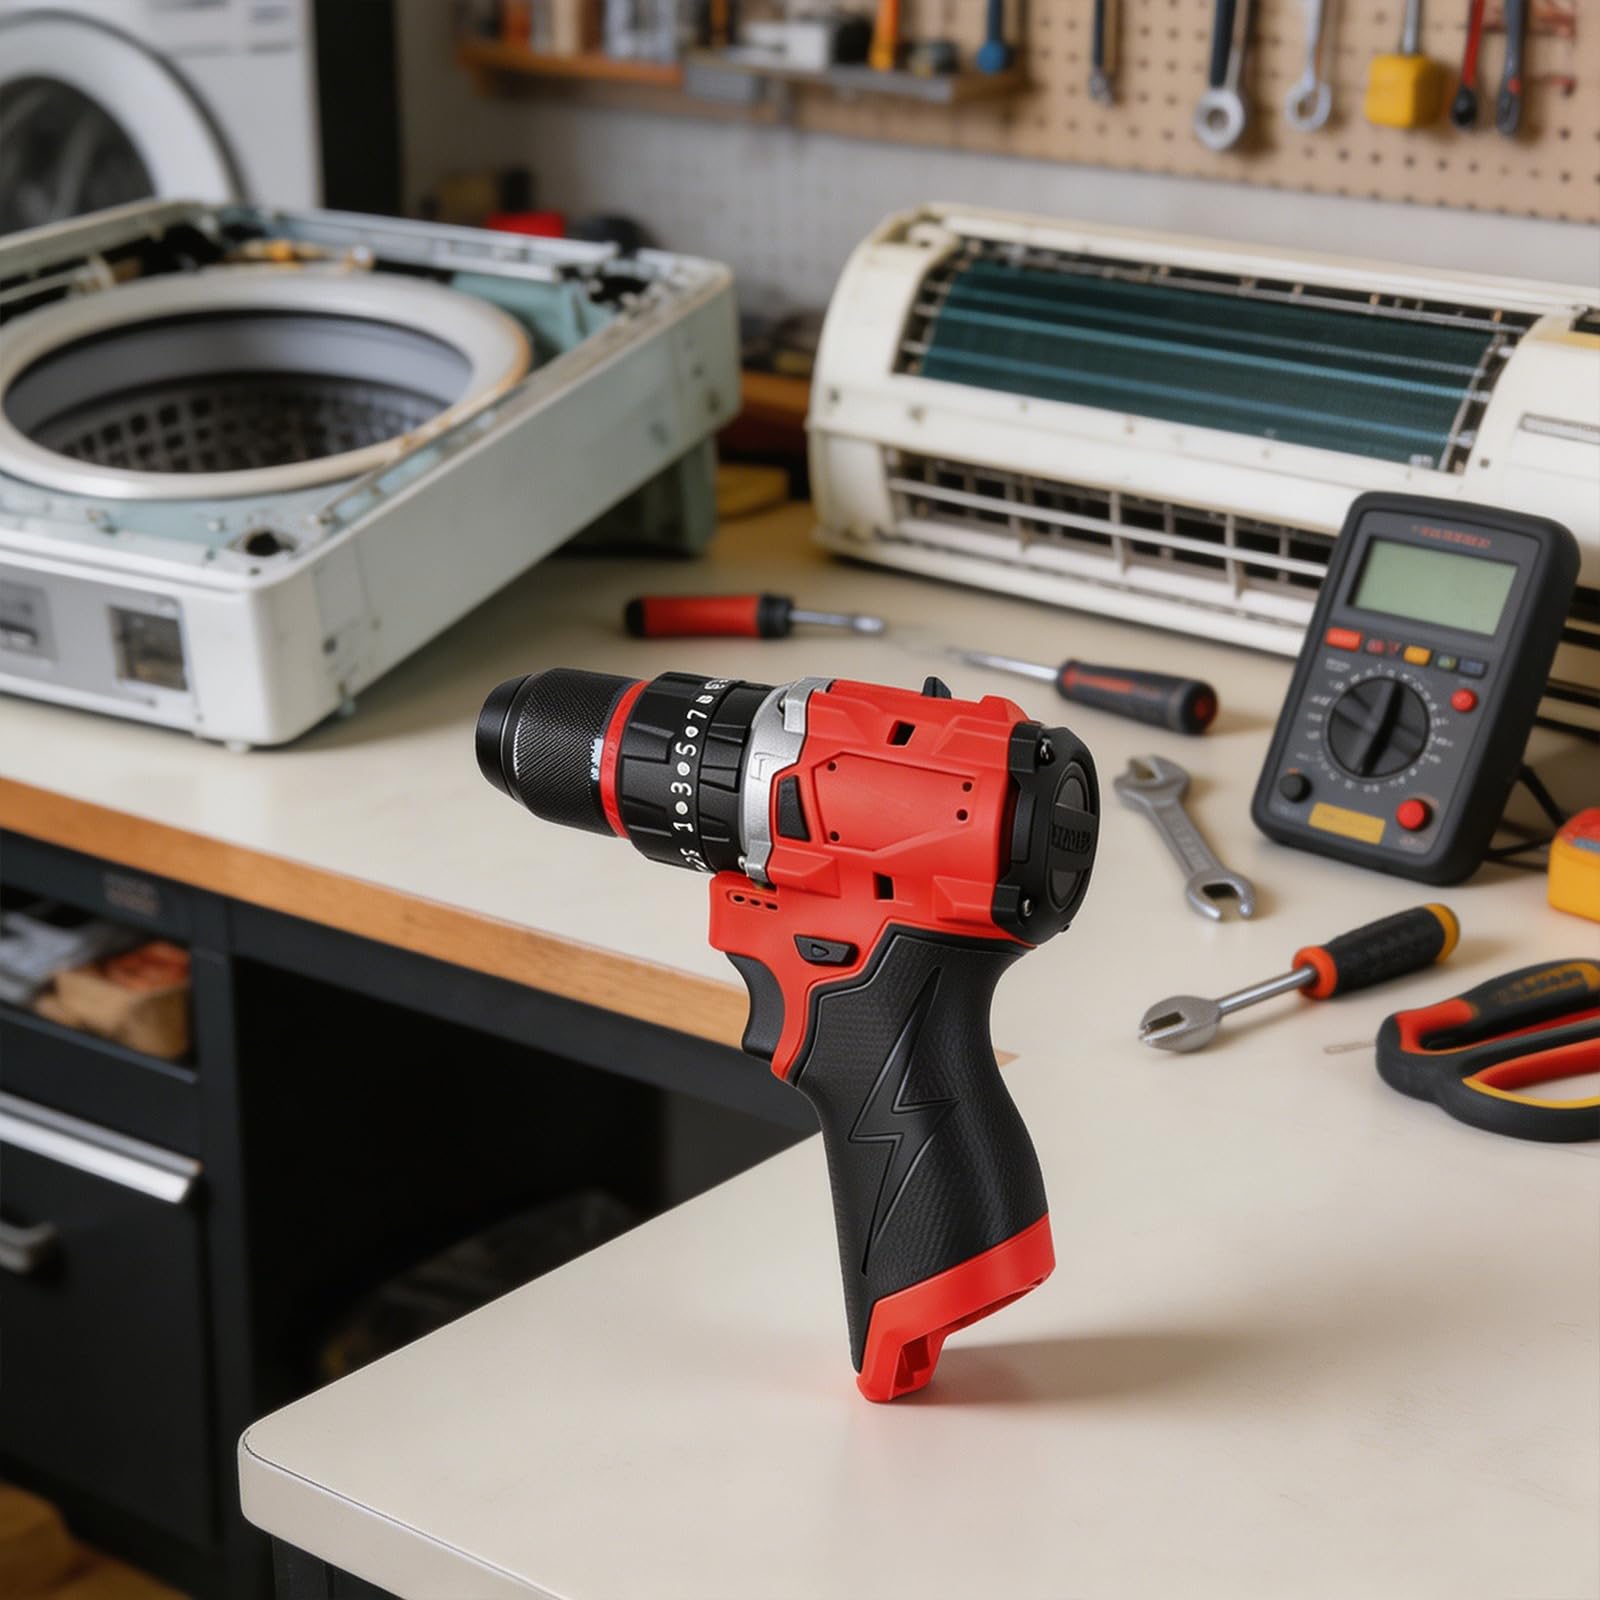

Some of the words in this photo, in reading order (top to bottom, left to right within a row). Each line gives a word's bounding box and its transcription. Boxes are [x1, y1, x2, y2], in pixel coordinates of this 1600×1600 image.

[686, 709, 708, 719] 7
[675, 741, 697, 756] 5
[670, 782, 692, 796] 3
[673, 822, 694, 833] 1
